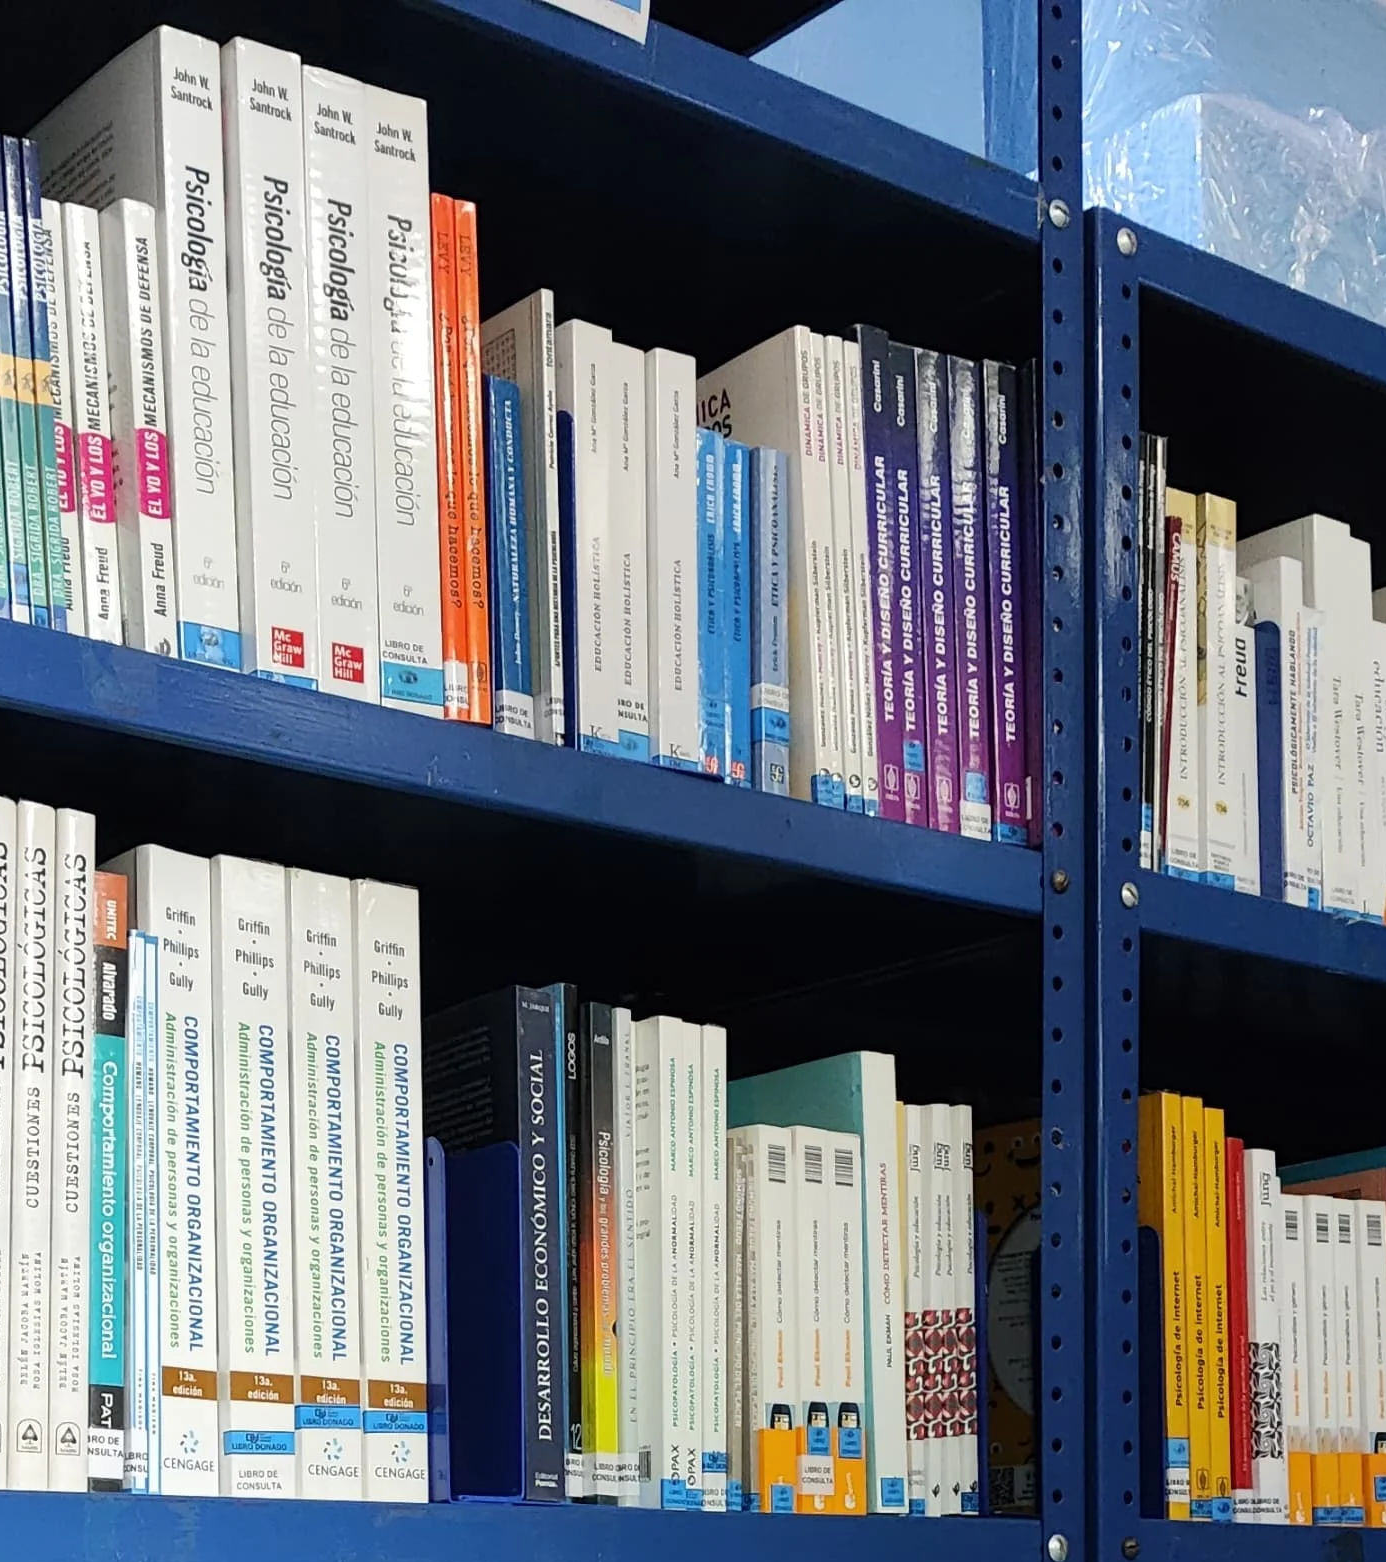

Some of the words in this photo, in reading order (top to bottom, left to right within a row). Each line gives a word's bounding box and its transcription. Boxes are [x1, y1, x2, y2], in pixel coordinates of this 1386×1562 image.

[173, 67, 196, 86] John
[171, 85, 213, 111] Santrock
[182, 166, 213, 292] Psicología
[139, 237, 152, 302] DEFENSA
[142, 305, 153, 325] DE
[190, 297, 214, 331] de
[191, 339, 214, 361] la
[143, 329, 158, 426] MECANISMOS
[872, 361, 883, 413] Casarini
[148, 433, 160, 461] LOS
[193, 365, 220, 497] educación
[149, 475, 162, 497] YO
[149, 498, 162, 517] EL
[874, 456, 889, 569] CURRICULAR
[152, 542, 166, 576] Freud
[154, 580, 166, 617] Anna
[877, 571, 892, 641] DISEÑO
[334, 645, 352, 658] Mc
[334, 656, 362, 670] Graw
[334, 667, 354, 681] Hill
[882, 655, 896, 722] TEORÍA
[239, 918, 271, 936] Griffin
[235, 949, 274, 970] Phillips
[102, 962, 118, 1021] Alvarado
[243, 982, 270, 1001] Gully
[237, 1021, 254, 1133] Administración
[567, 1033, 576, 1080] LOGOS
[529, 1049, 546, 1126] SOCIAL
[257, 1024, 277, 1194] COMPORTAMIENTO
[99, 1060, 118, 1216] Comportamiento
[240, 1136, 254, 1153] de
[532, 1132, 545, 1147] Y
[239, 1157, 255, 1224] personas
[1260, 1172, 1271, 1208] Jung
[241, 1228, 254, 1239] y
[531, 1154, 550, 1293] ECONÓMICO
[99, 1221, 119, 1361] organizacional
[242, 1241, 257, 1354] organizaciones
[262, 1200, 281, 1357] ORGANIZACIONAL
[1172, 1272, 1183, 1321] internet
[535, 1298, 553, 1442] DESARROLLO
[1172, 1344, 1184, 1407] Psicología
[247, 1389, 279, 1401] edición
[163, 1457, 215, 1472] CENGAGE
